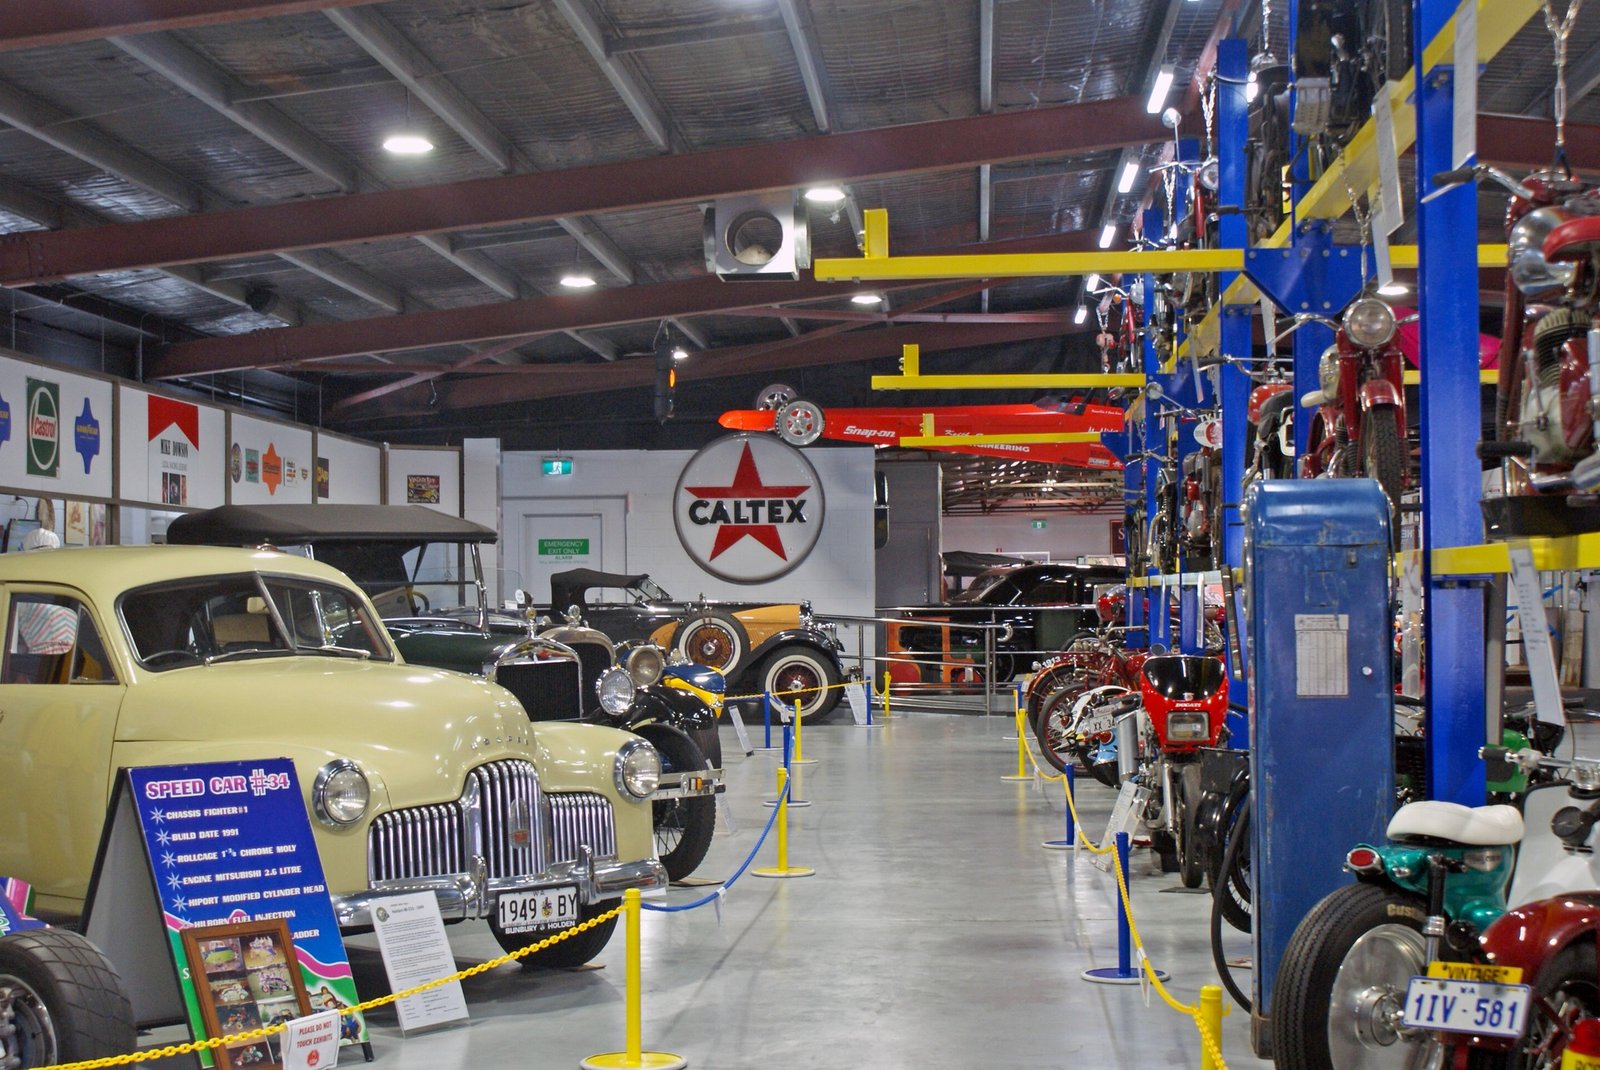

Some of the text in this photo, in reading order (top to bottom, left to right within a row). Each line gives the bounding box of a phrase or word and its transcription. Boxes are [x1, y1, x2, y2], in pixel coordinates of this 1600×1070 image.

[34, 416, 57, 439] Castrol
[843, 425, 896, 438] Snap-on
[688, 499, 807, 525] CALTEX
[543, 540, 584, 548] EMERGENCY
[1042, 656, 1061, 668] 1913
[146, 768, 290, 800] SPEED CAR #34
[166, 809, 201, 820] CHASSIS
[171, 828, 239, 841] BUILD DATE 1991
[177, 851, 219, 863] ROLLCAGE
[240, 848, 274, 857] CHROME
[276, 844, 297, 853] MOLY
[182, 865, 302, 885] ENGINE MITSUBISHI 2.6 LITRE
[188, 884, 325, 907] HIPORT MODIFIED CYLINDER HEAD
[500, 898, 537, 923] 1949
[558, 893, 577, 917] BY
[255, 910, 296, 922] INJECTION
[505, 925, 537, 935] BUNBURY
[547, 920, 576, 930] HOLDEN
[1448, 966, 1501, 983] VINTAGE
[1460, 986, 1475, 994] WA
[299, 1020, 332, 1035] PLEASE DO NOT
[297, 1033, 333, 1048] TOUCH EXHIBITS
